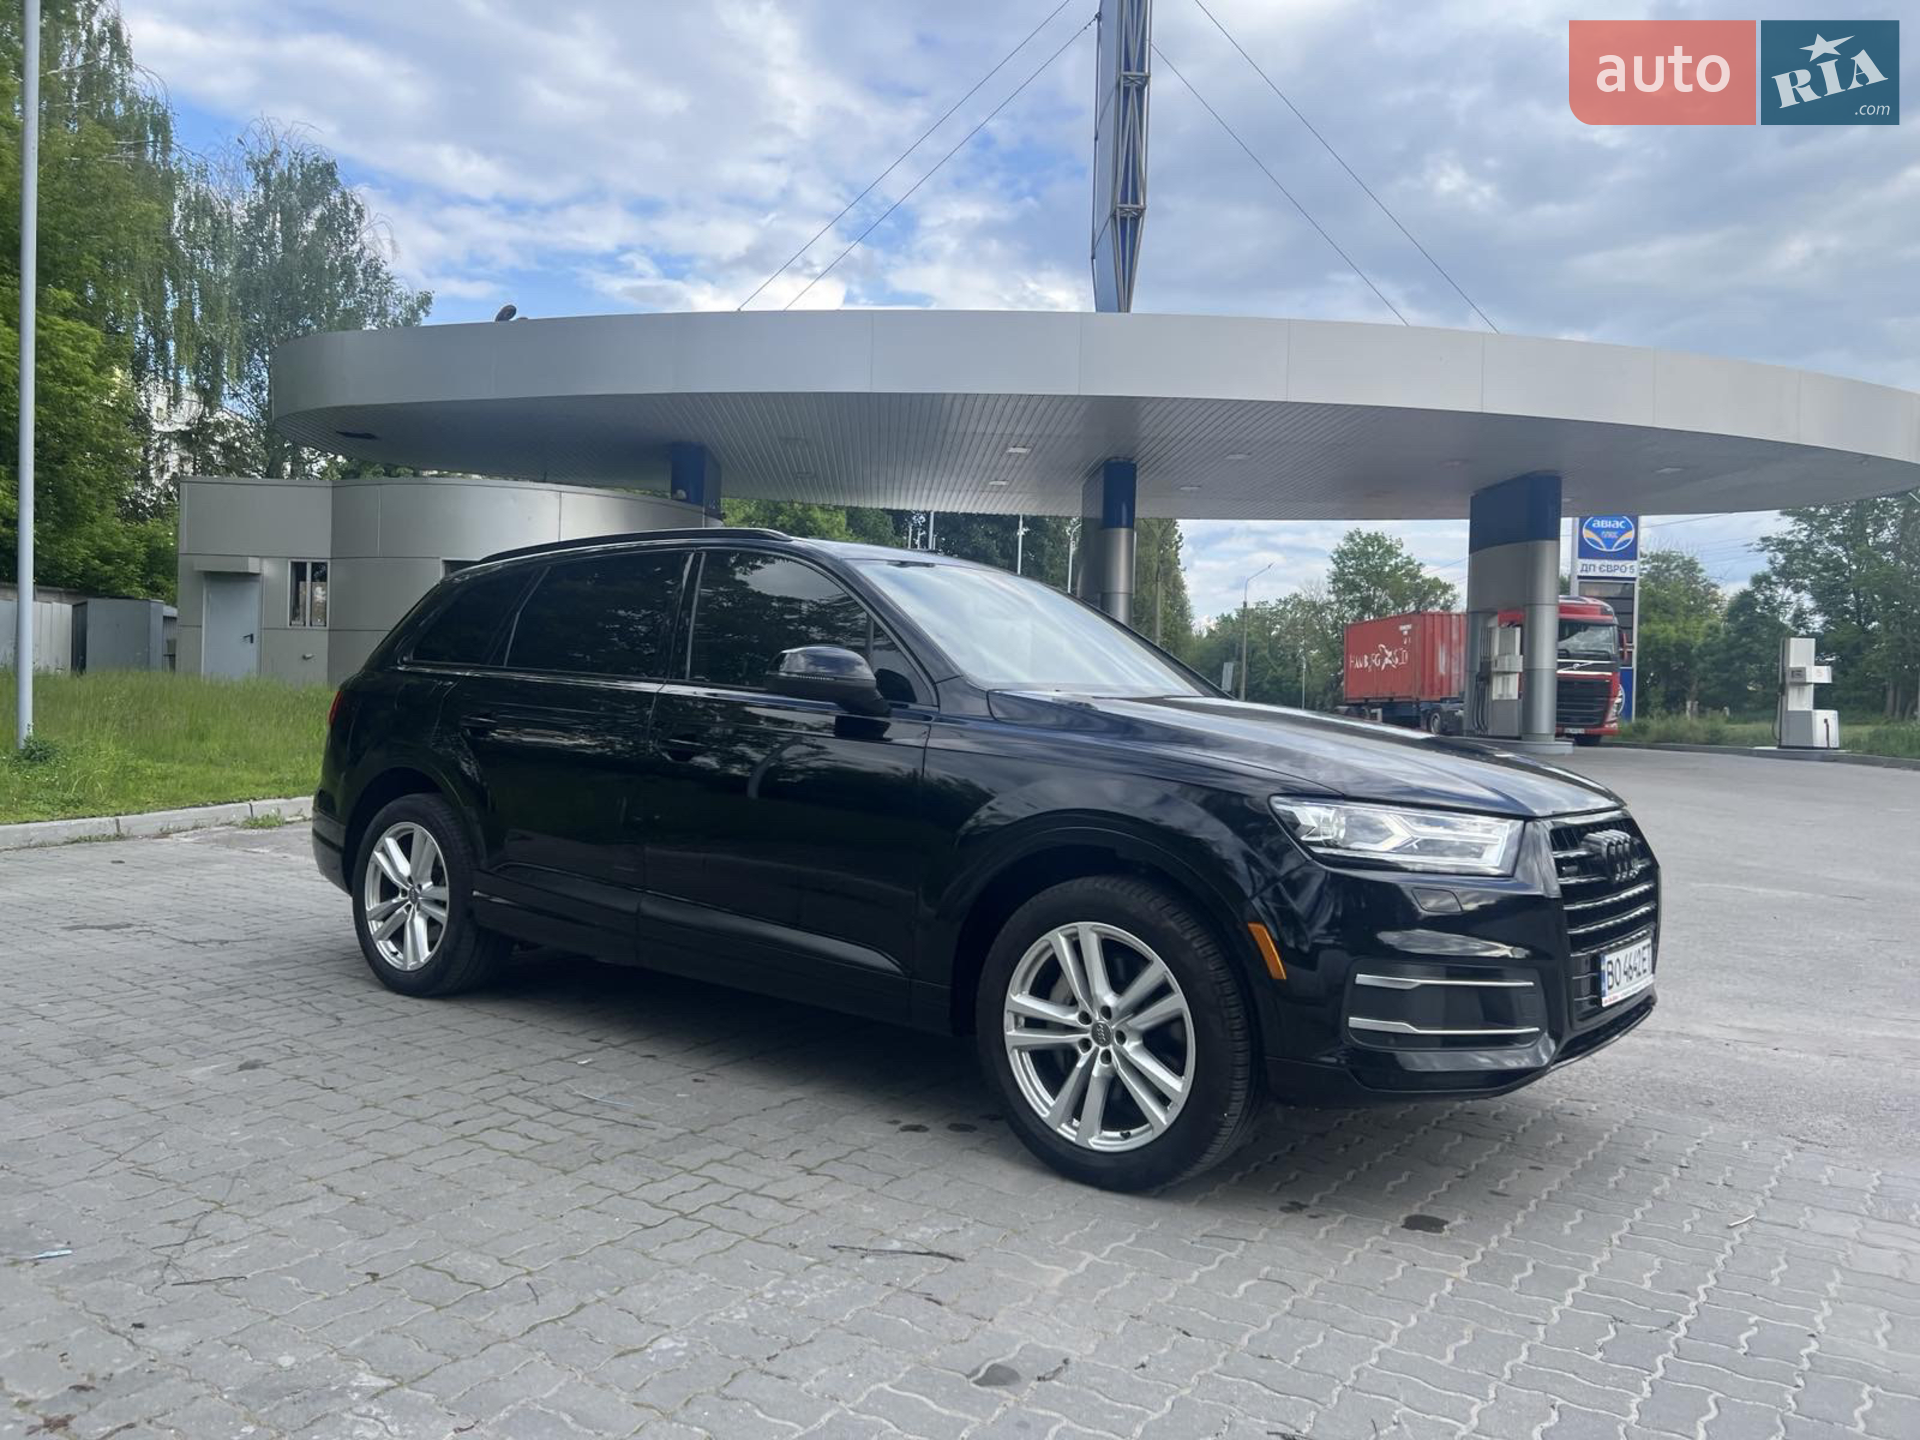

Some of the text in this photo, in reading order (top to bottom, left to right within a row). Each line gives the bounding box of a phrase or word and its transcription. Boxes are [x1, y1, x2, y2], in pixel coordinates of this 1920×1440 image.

[1580, 563, 1635, 573] ДП ЄВРО 5
